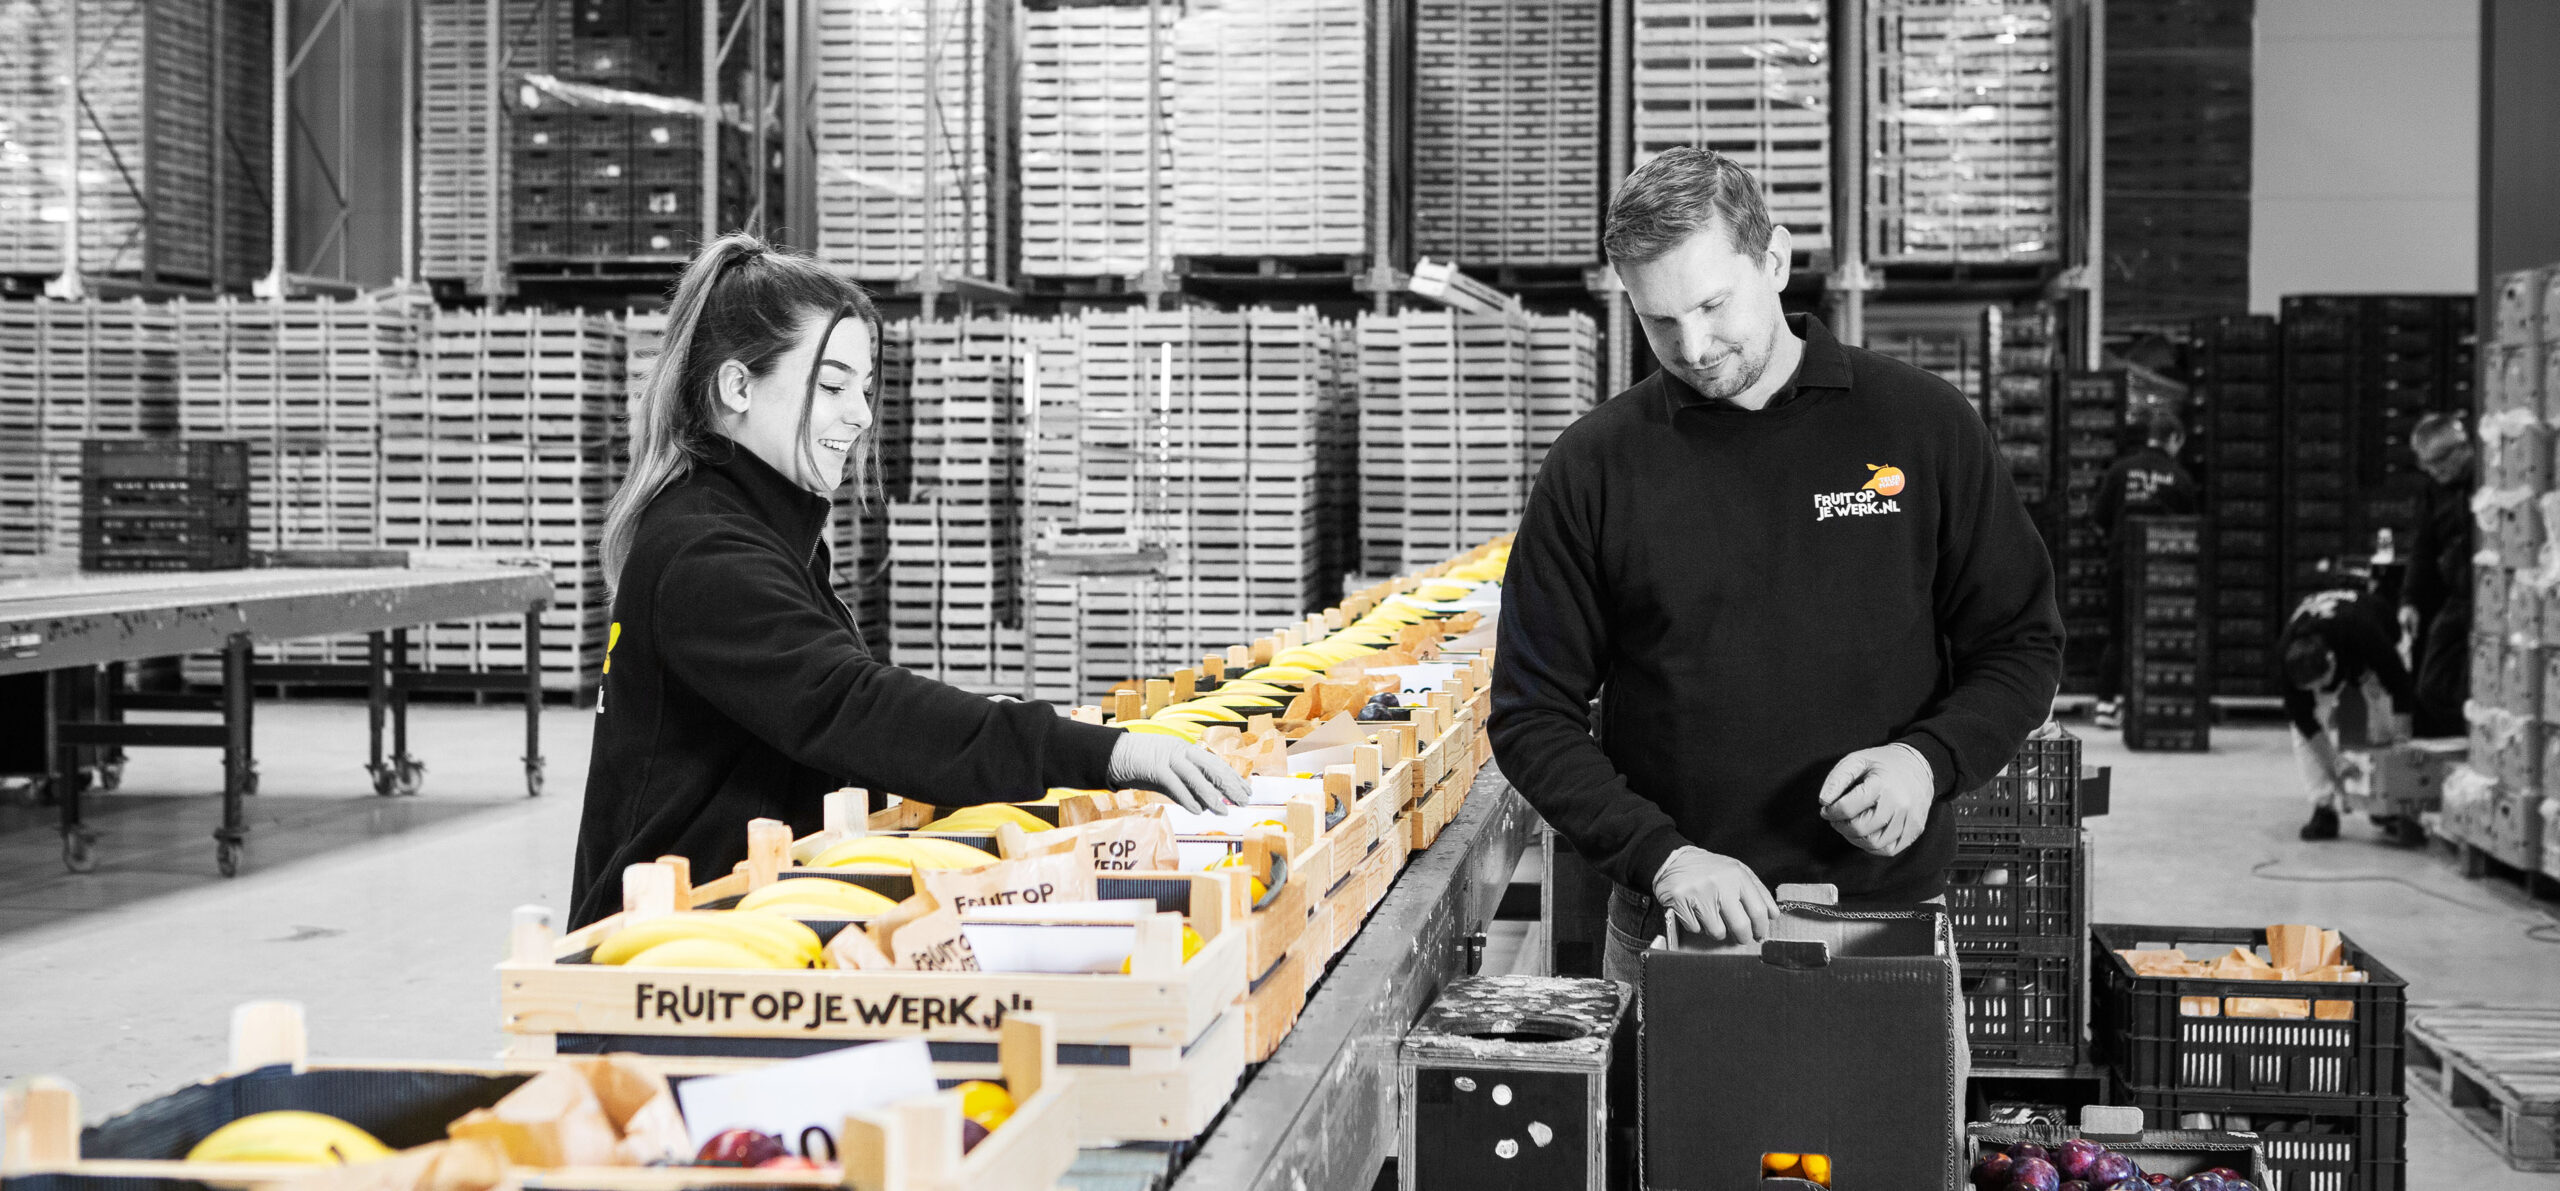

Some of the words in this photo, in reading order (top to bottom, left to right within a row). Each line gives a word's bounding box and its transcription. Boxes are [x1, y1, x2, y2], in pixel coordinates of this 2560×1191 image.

[1814, 492, 1855, 508] FRUIT
[1855, 490, 1876, 502] OP
[1816, 506, 1834, 521] JE
[1834, 499, 1901, 517] WERK.NL
[1109, 840, 1136, 857] OP
[1022, 883, 1054, 903] OP
[637, 984, 745, 1023] FRUIT
[752, 991, 803, 1020] OP
[804, 992, 848, 1029] JE
